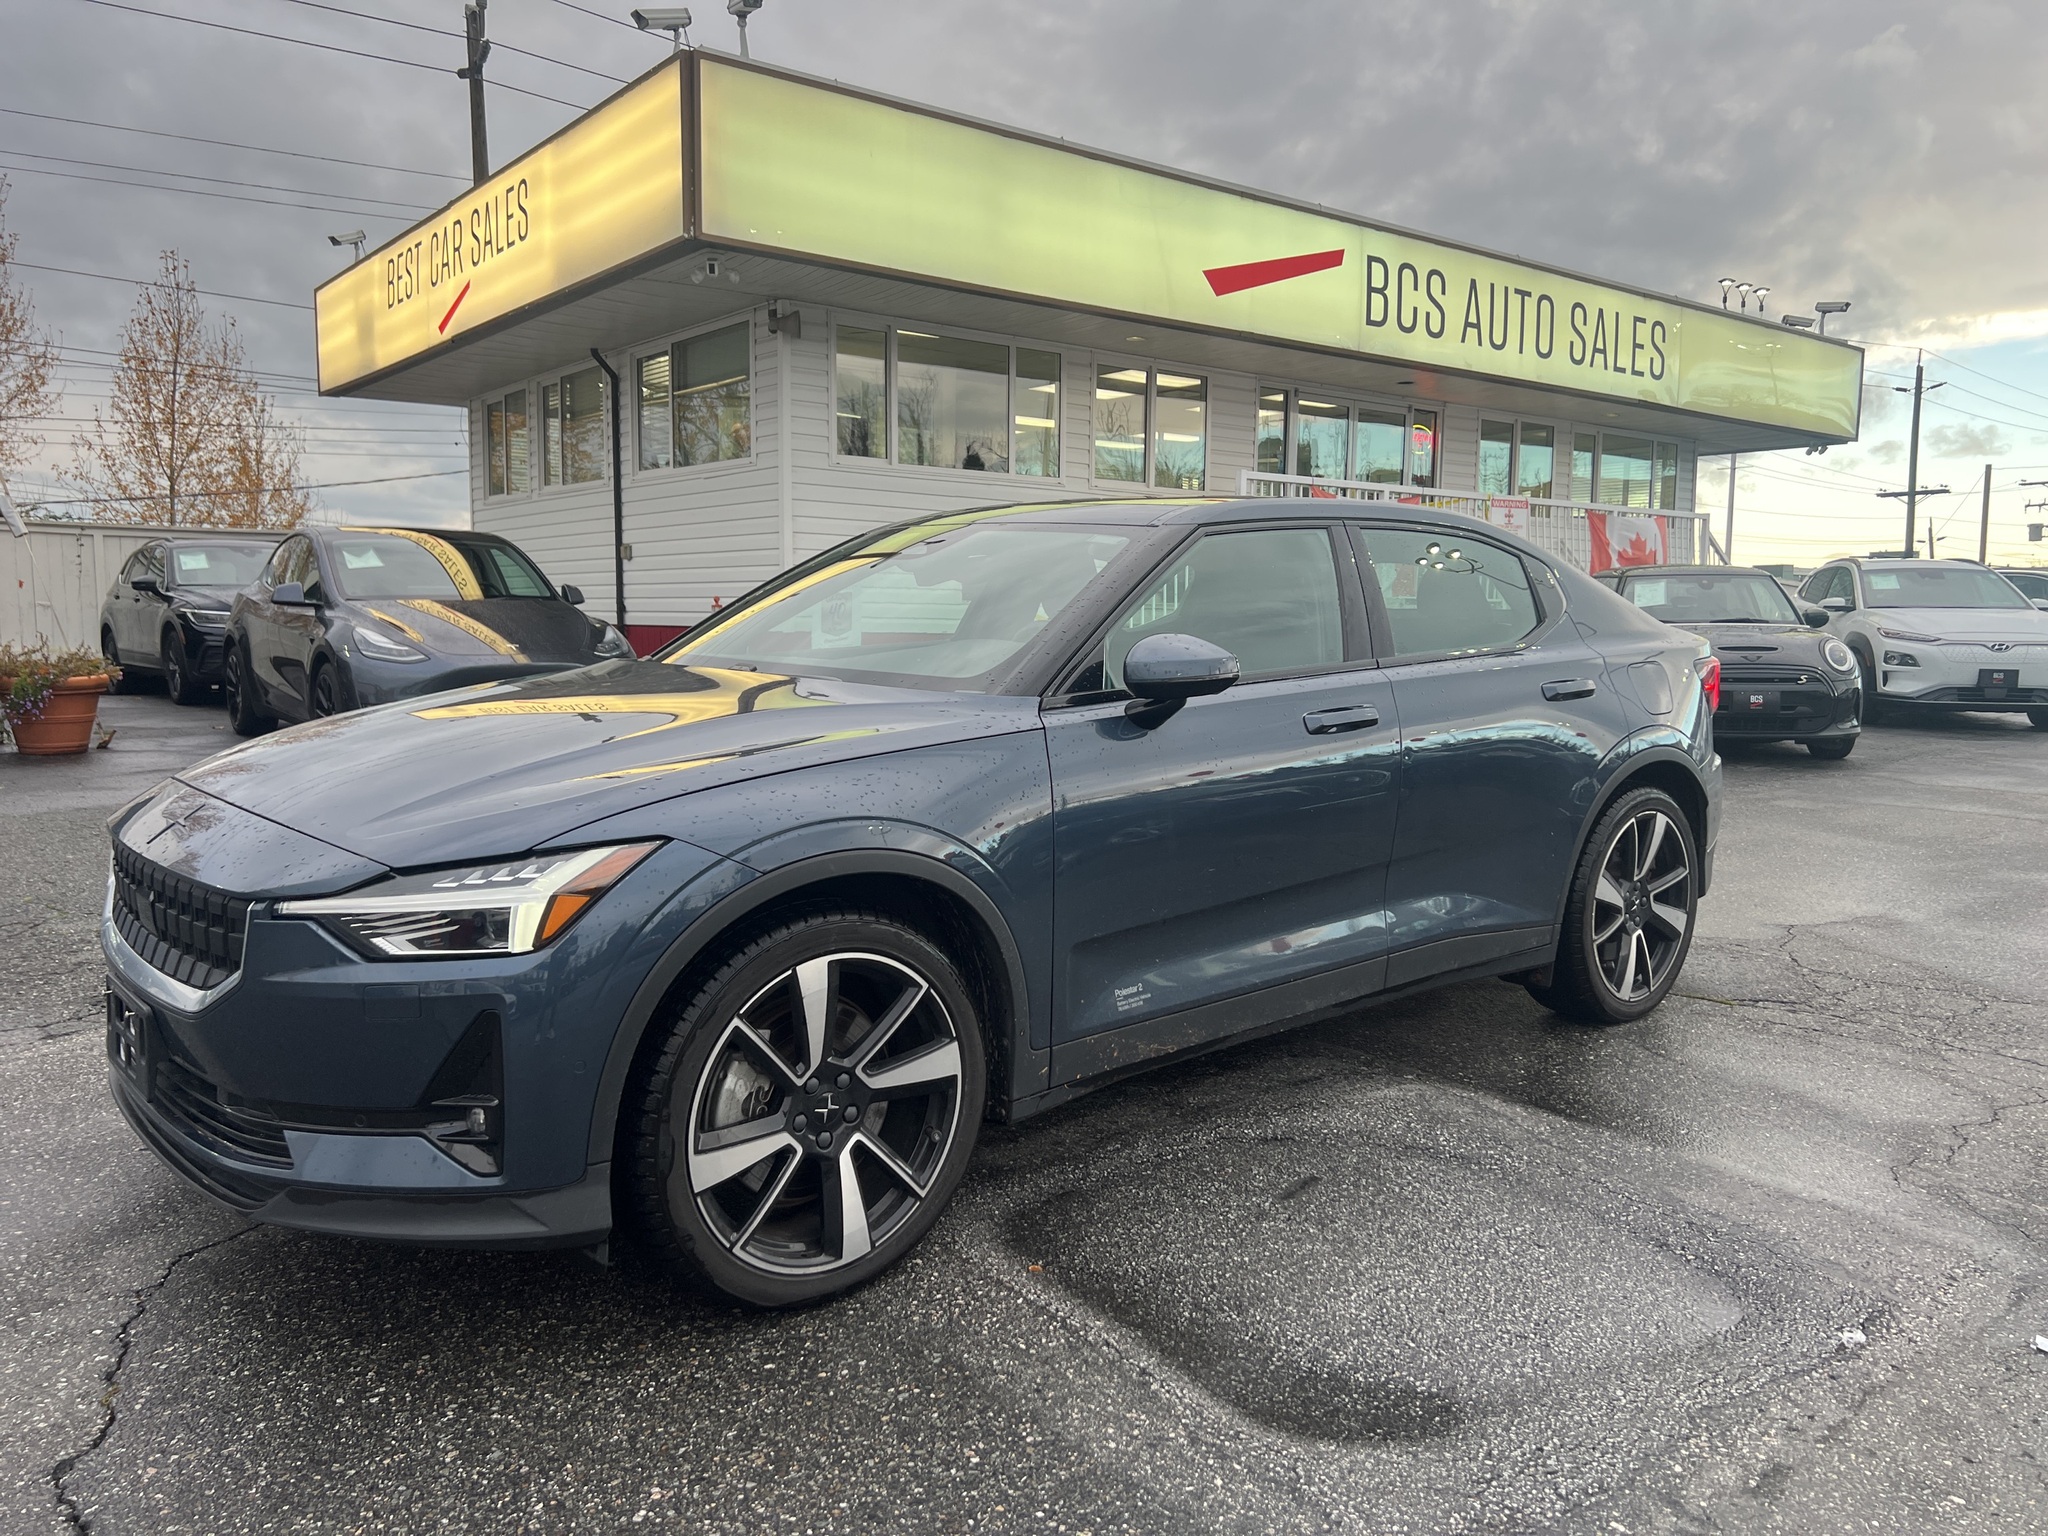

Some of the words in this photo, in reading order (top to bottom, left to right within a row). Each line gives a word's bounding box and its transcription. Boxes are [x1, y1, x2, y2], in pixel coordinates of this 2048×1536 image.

[387, 240, 422, 309] BEST
[429, 218, 464, 288] CAR
[470, 178, 529, 267] SALES
[1365, 254, 1447, 339] BCS
[1460, 277, 1556, 360] AUTO
[1569, 301, 1667, 381] SALES
[1492, 500, 1527, 509] WARNING
[1797, 675, 1808, 684] S
[1750, 695, 1763, 703] BCS
[1115, 985, 1138, 997] Polestar
[1138, 982, 1143, 991] 2
